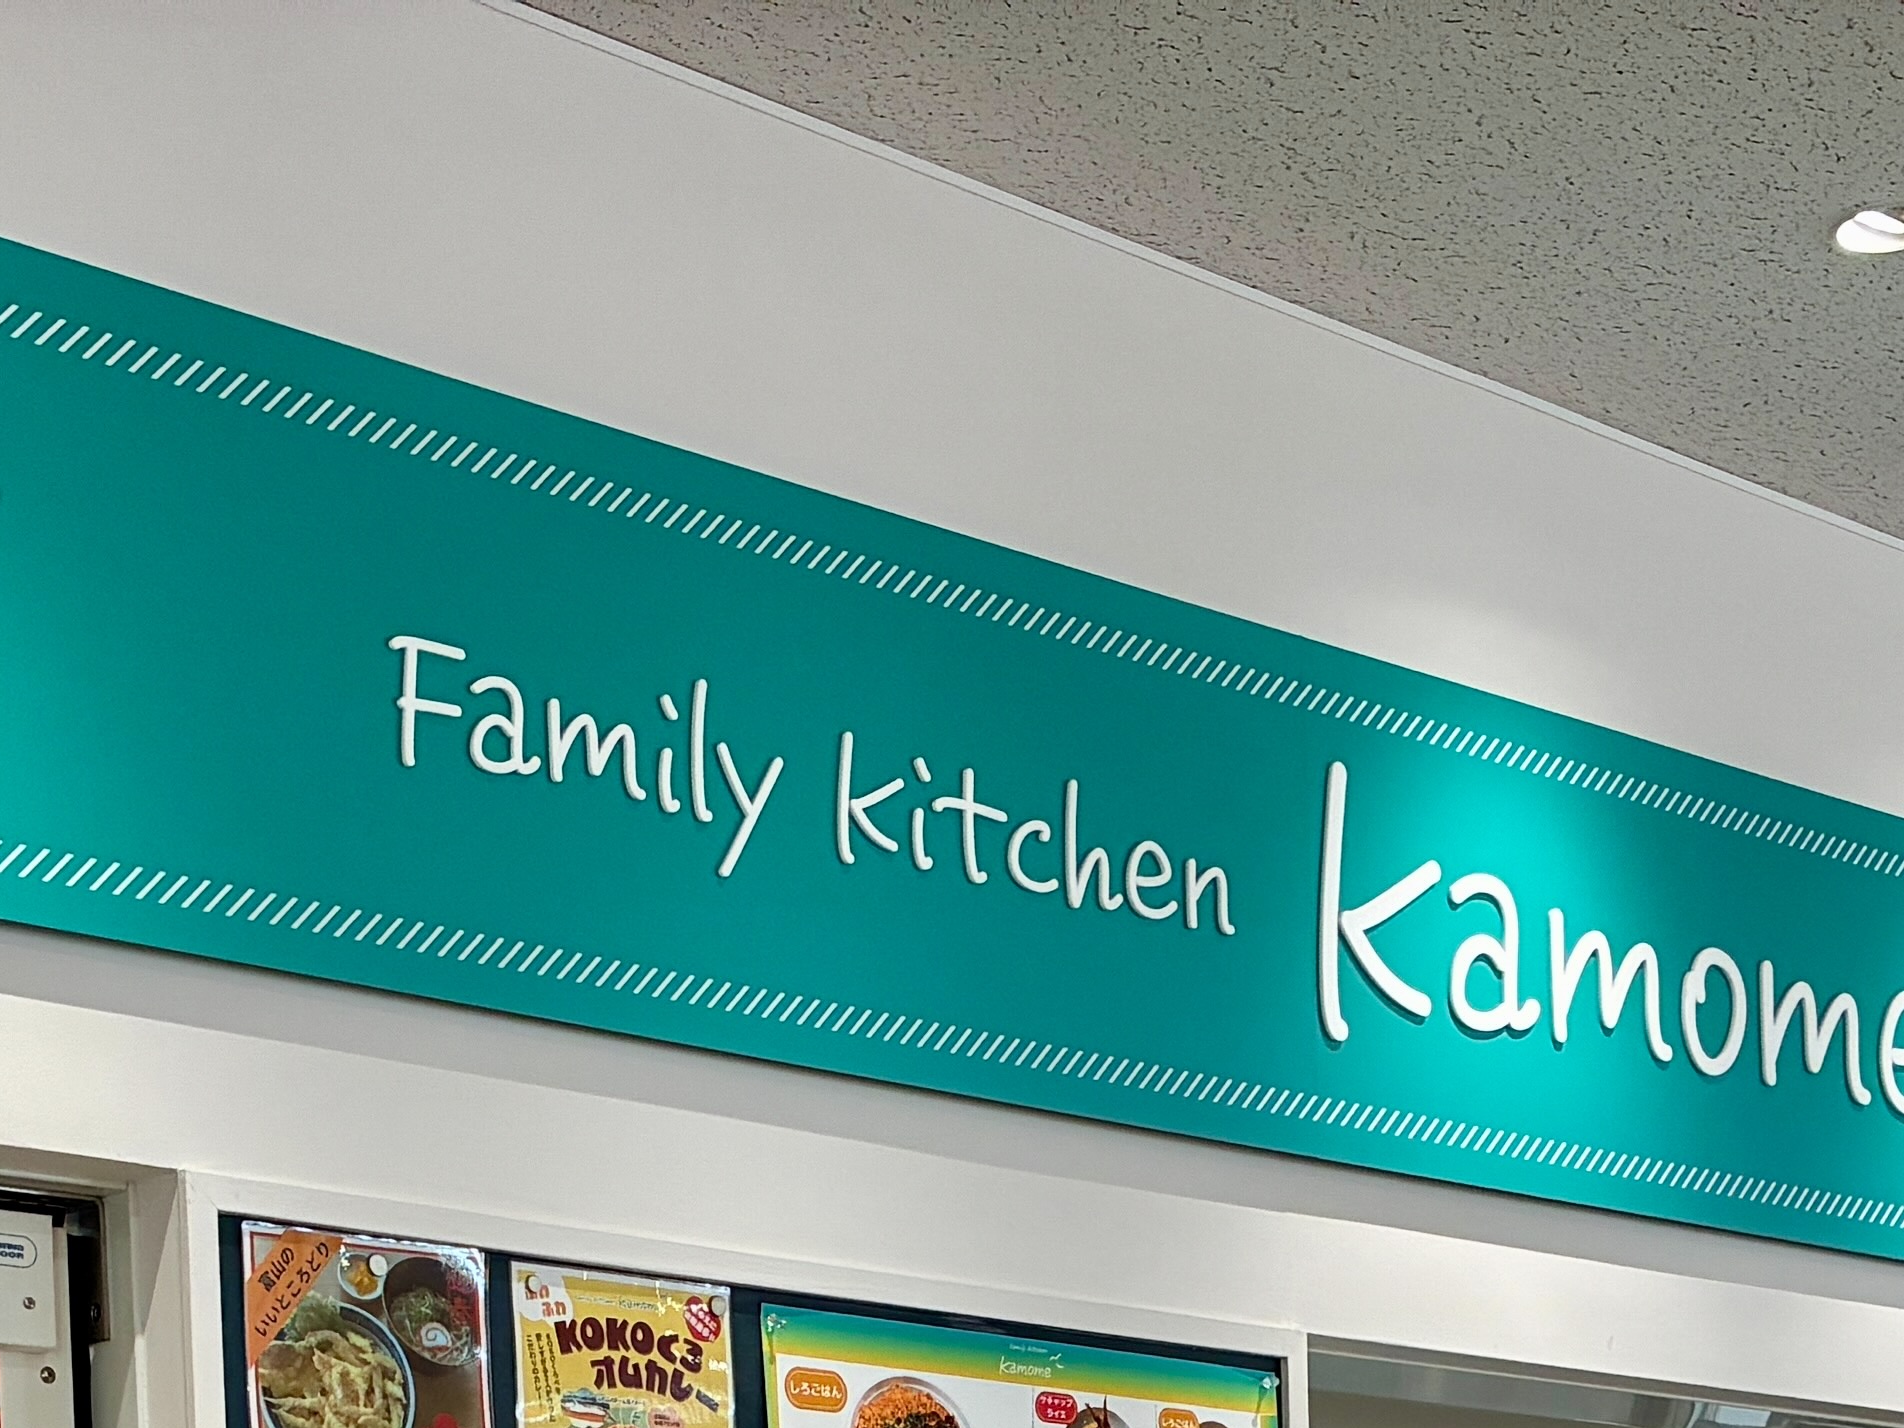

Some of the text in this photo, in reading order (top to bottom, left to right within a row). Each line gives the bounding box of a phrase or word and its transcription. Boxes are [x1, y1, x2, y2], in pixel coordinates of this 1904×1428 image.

[389, 634, 784, 879] Family
[837, 730, 1235, 935] kitchen
[255, 1240, 332, 1339] いいところどり
[257, 1245, 295, 1292] 富山の
[554, 1317, 704, 1374] KOKOくろ
[999, 1354, 1052, 1379] kamome
[590, 1355, 720, 1413] オムカレー
[790, 1383, 843, 1399] しろごはん
